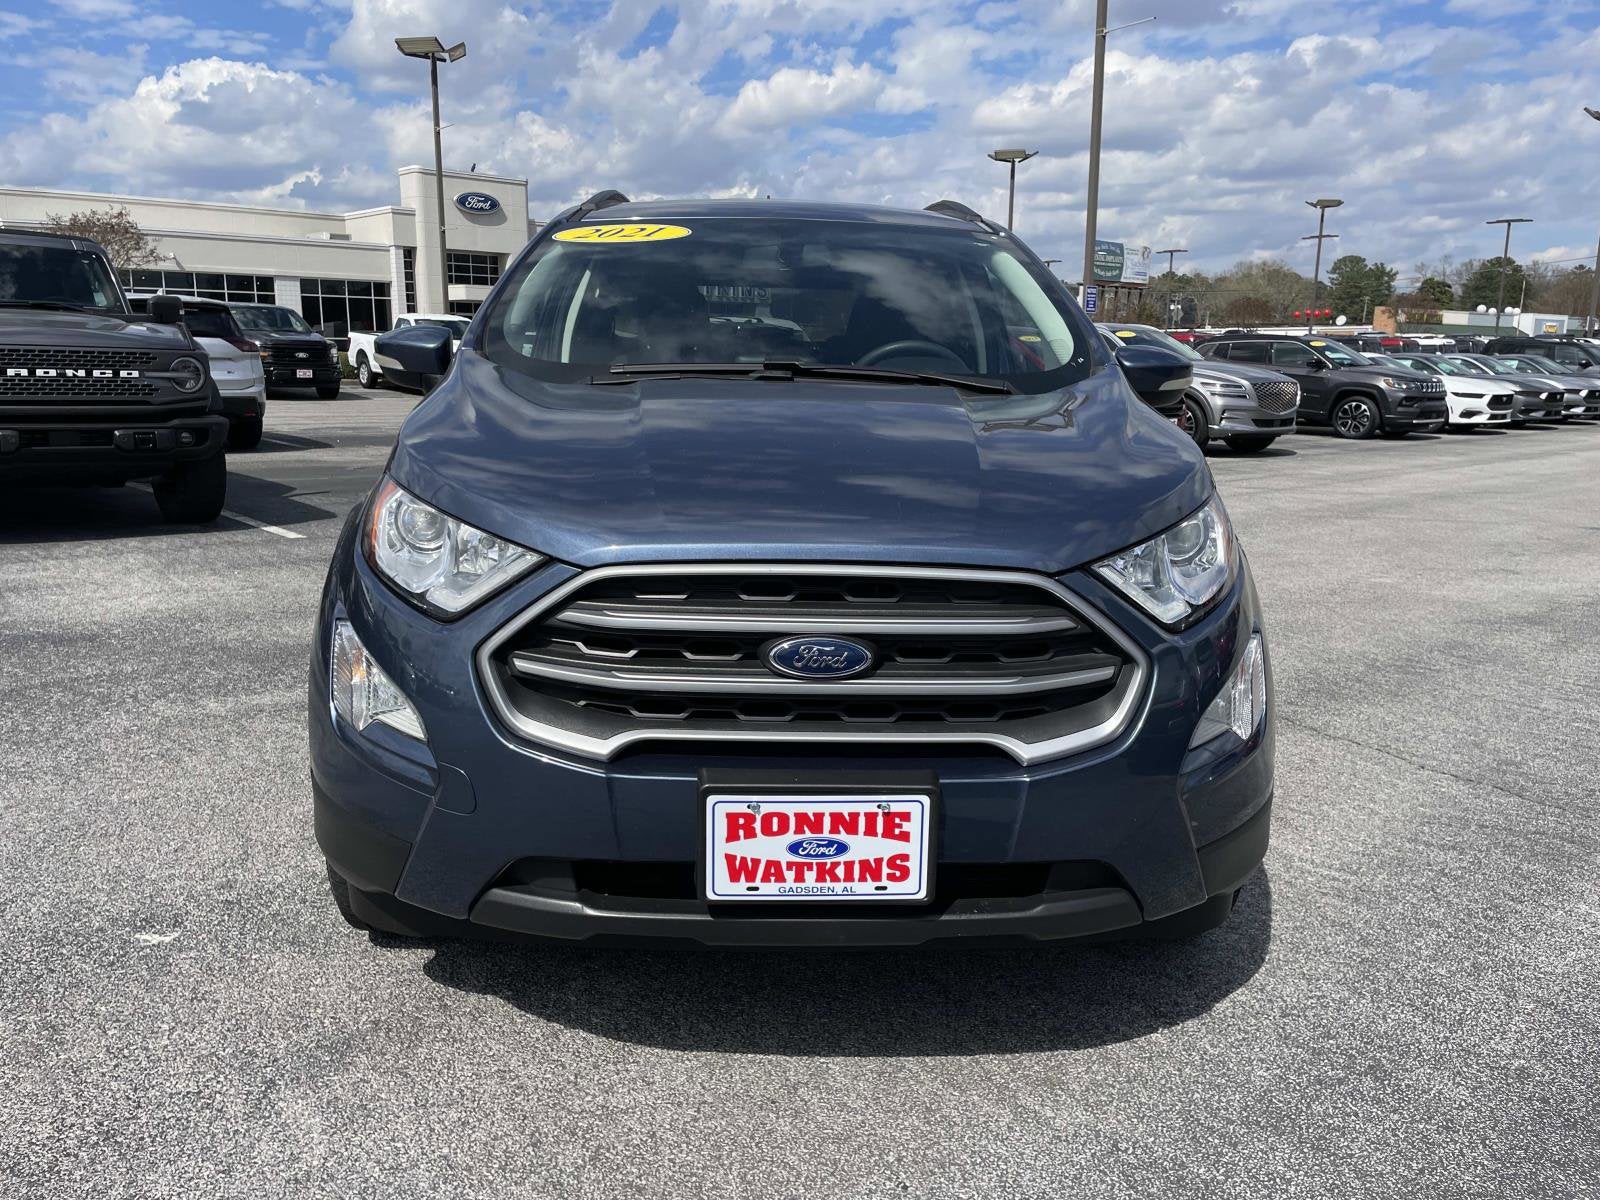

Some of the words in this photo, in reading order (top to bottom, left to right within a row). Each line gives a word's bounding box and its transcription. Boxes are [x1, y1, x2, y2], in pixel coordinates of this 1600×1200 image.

[465, 195, 491, 210] Ford
[575, 227, 666, 239] 2021
[6, 368, 140, 378] RONCO
[793, 644, 848, 669] Ford
[724, 811, 912, 844] RONNIE
[798, 840, 837, 856] Ford
[724, 852, 911, 884] WATKINS
[778, 886, 838, 895] GADSDEN,
[841, 886, 857, 894] AL
